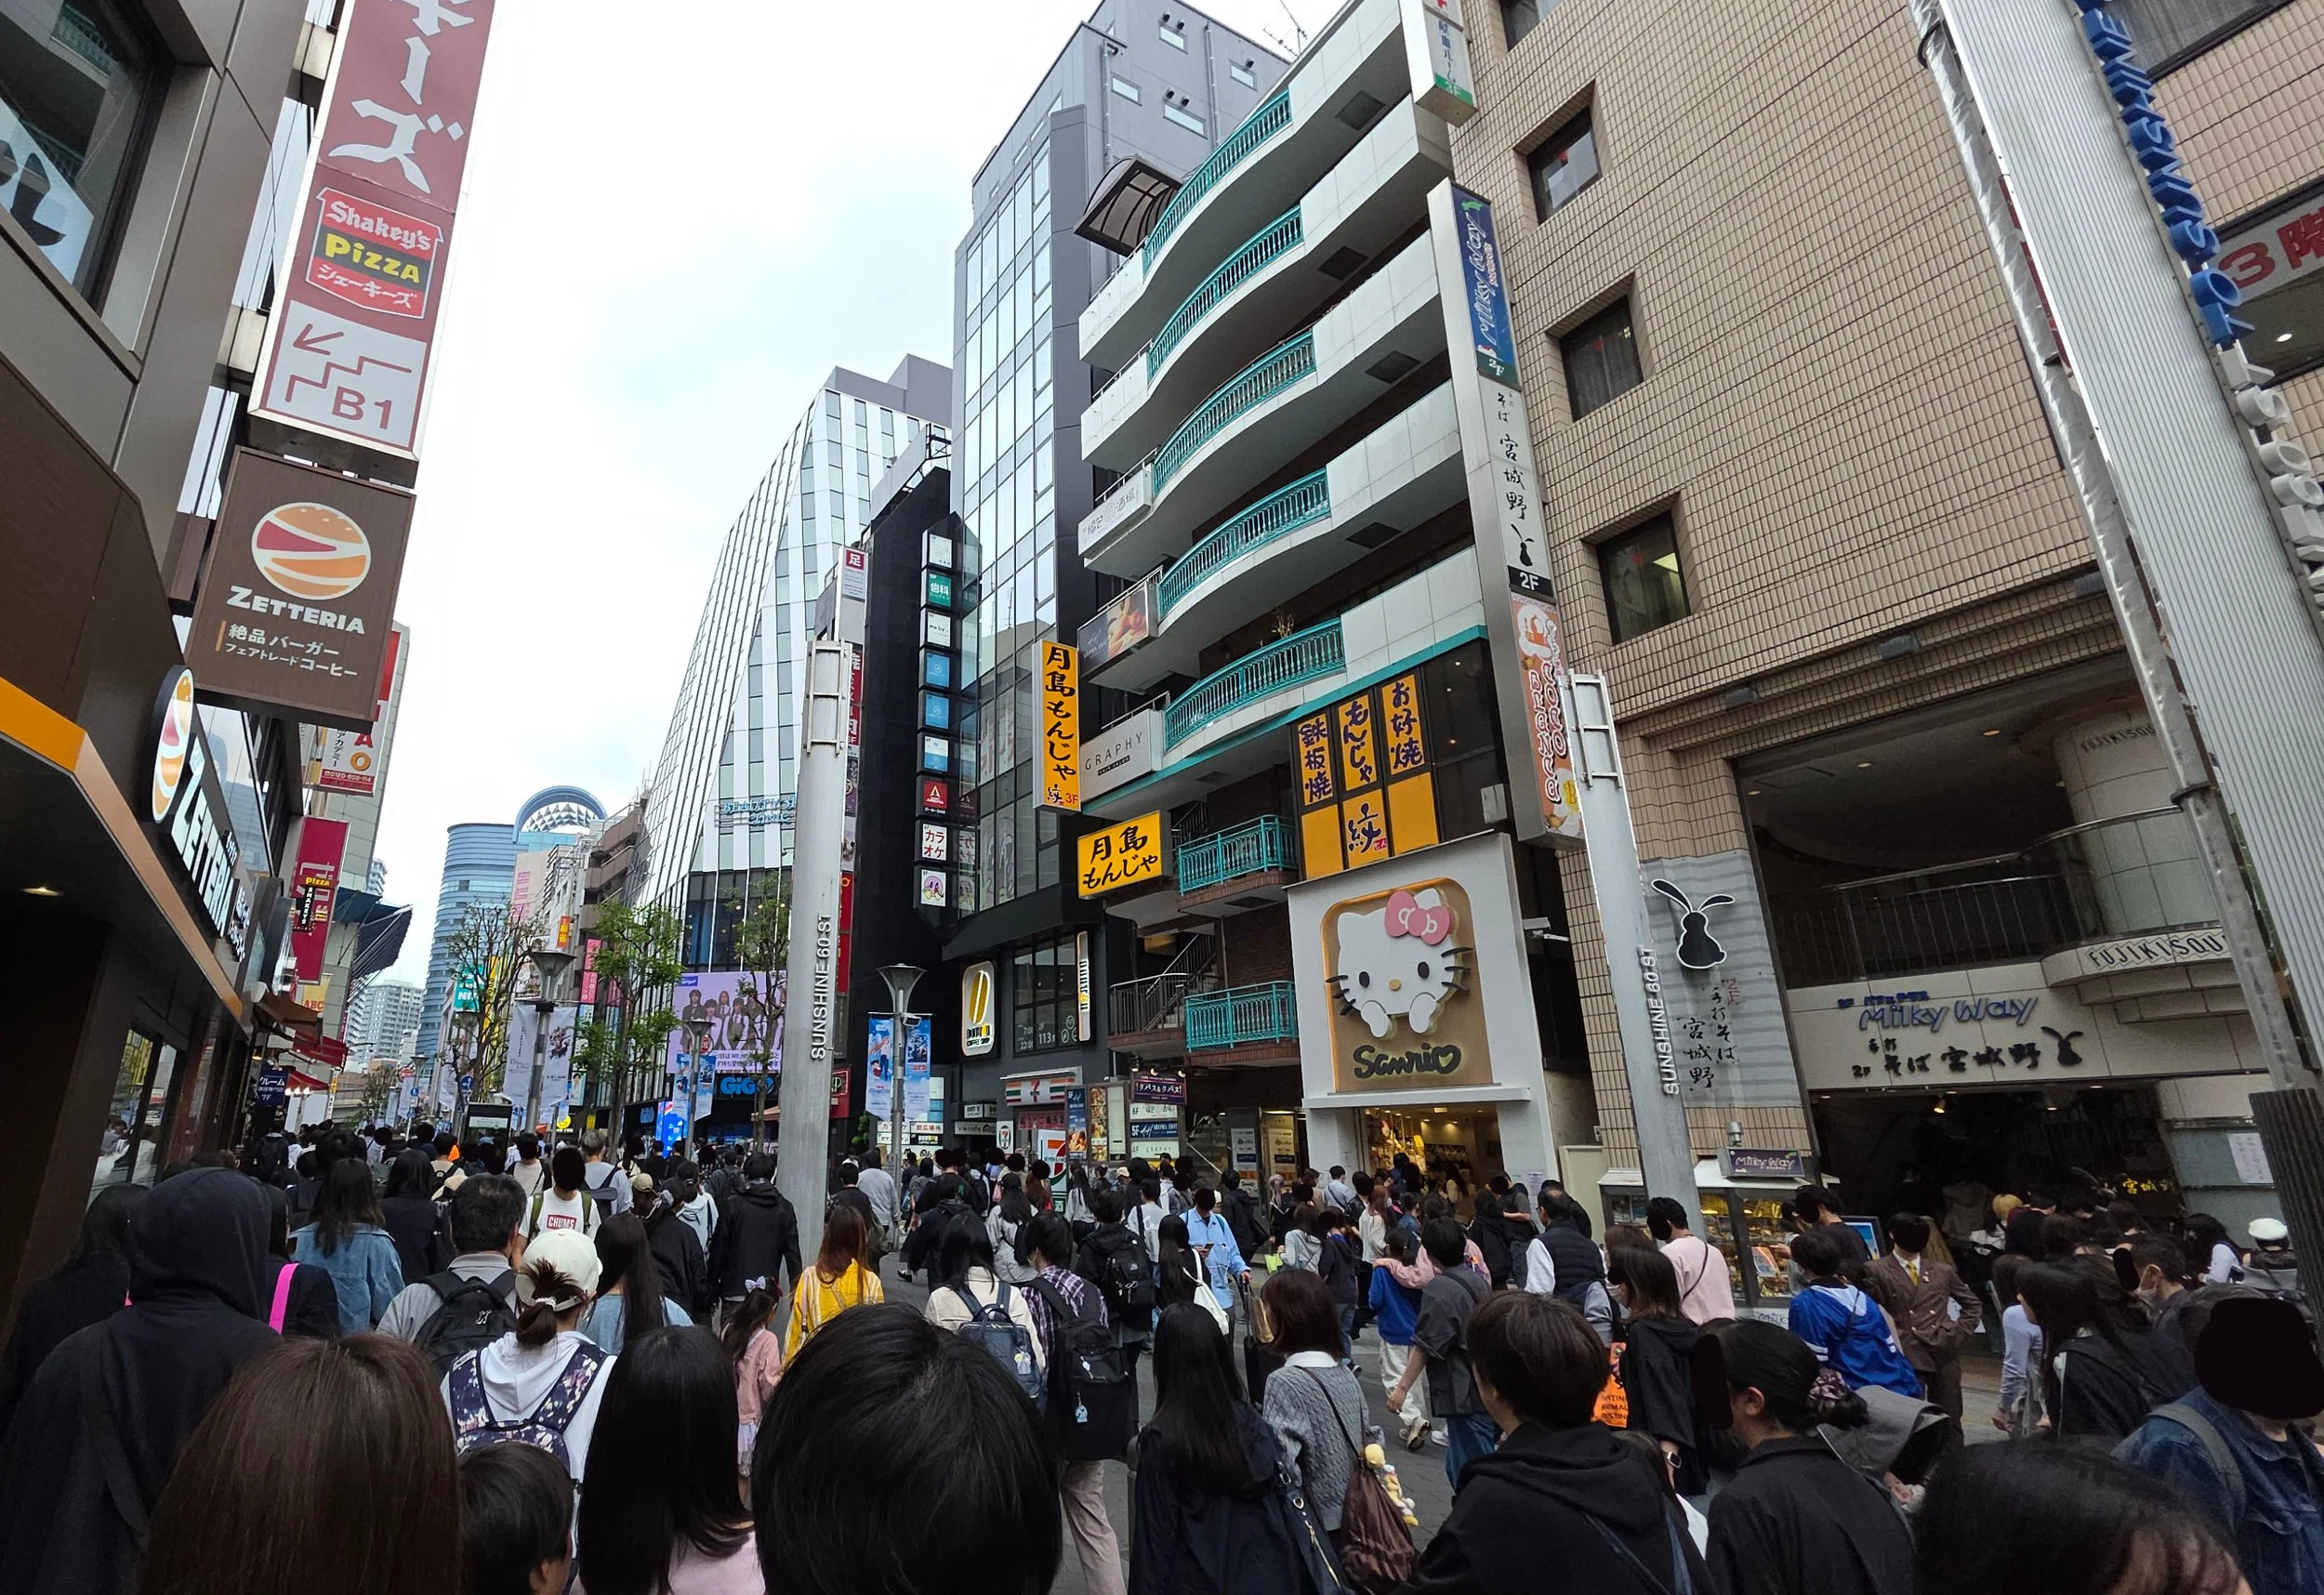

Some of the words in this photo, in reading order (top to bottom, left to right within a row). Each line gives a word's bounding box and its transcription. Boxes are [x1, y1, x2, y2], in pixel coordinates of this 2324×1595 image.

[325, 201, 431, 252] Shakey's
[317, 263, 418, 310] シェーキーズ
[1487, 357, 1505, 377] 2F
[331, 386, 392, 430] B1
[1499, 433, 1527, 521] 宮城野
[848, 553, 862, 567] 足
[930, 583, 949, 597] 歯科
[1518, 571, 1539, 591] 2F
[226, 585, 365, 635] ZETTERIA
[1043, 646, 1077, 782] 月島もんじゃ
[1390, 681, 1424, 771] お好焼
[332, 729, 346, 768] アカデミー
[1084, 731, 1143, 771] GRAPHY
[1299, 717, 1333, 804] 鉄板焼
[1343, 700, 1372, 783] もんじゃ
[1064, 791, 1079, 805] 3F
[924, 844, 945, 858] オケ
[925, 829, 945, 844] カラ
[1089, 824, 1148, 864] 月島
[1082, 853, 1159, 890] もんじゃ
[818, 912, 832, 932] ST
[816, 937, 831, 958] 60
[1638, 944, 1657, 968] ST
[2088, 934, 2227, 968] FUJIKISQU
[1643, 972, 1661, 994] 60
[812, 963, 829, 1061] SUNSHINE
[1859, 1003, 1950, 1034] Milky
[1953, 995, 2039, 1026] Way
[1647, 996, 1681, 1096] SUNSHINE
[1684, 1018, 1715, 1089] 宮城野
[1736, 1155, 1766, 1170] Milky
[1768, 1157, 1796, 1170] Way
[548, 1216, 576, 1230] CHUMS
